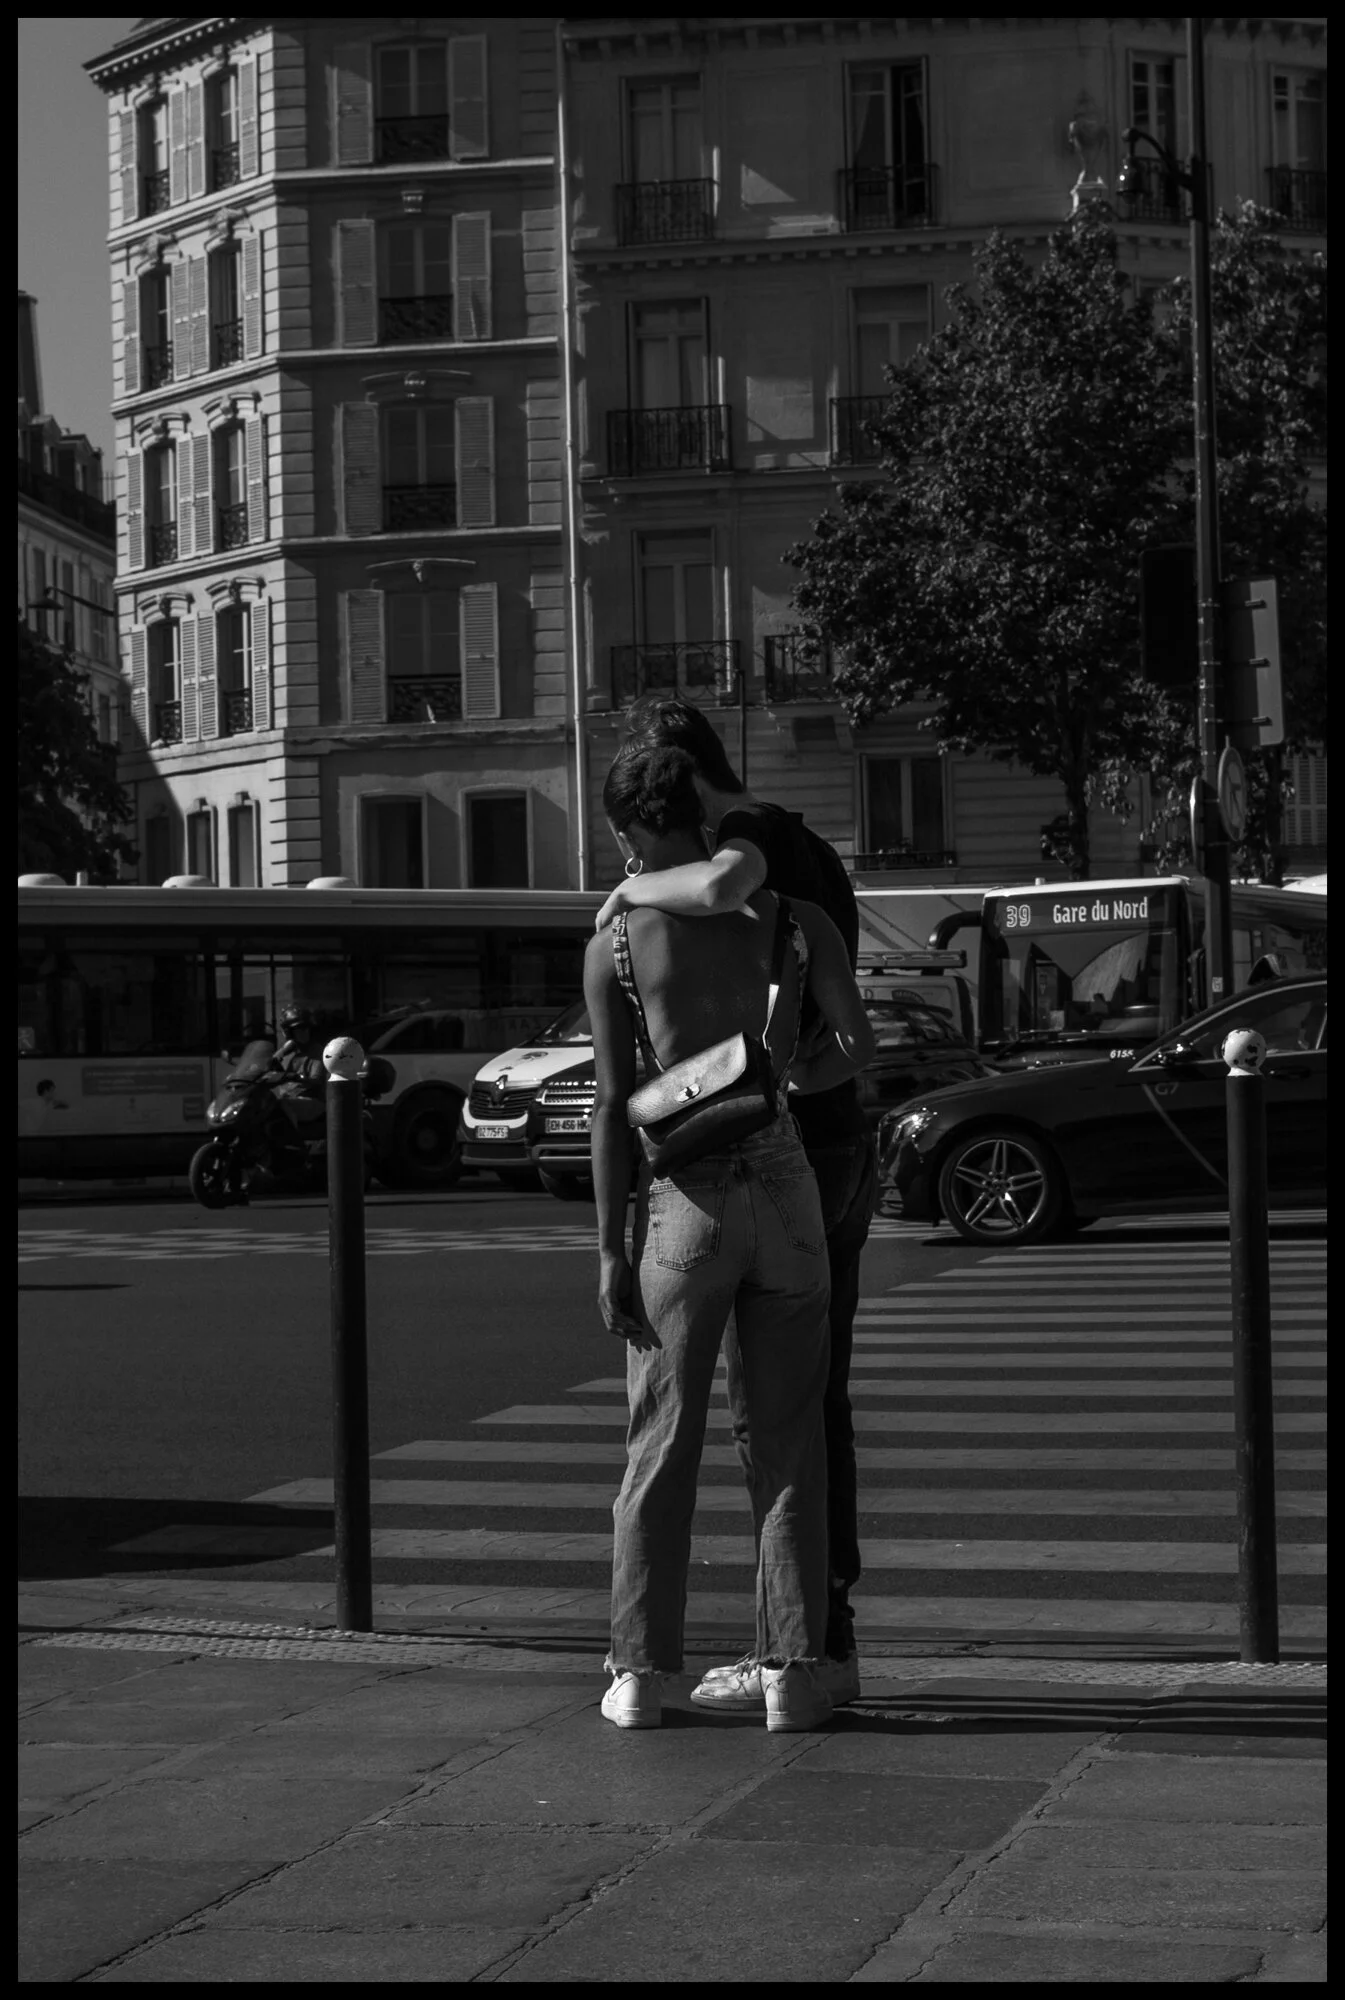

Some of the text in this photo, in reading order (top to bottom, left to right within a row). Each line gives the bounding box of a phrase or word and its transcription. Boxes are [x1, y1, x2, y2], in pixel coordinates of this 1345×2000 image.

[1005, 904, 1031, 928] 39
[1052, 896, 1148, 924] Gare du Nord
[1154, 1081, 1179, 1096] G7
